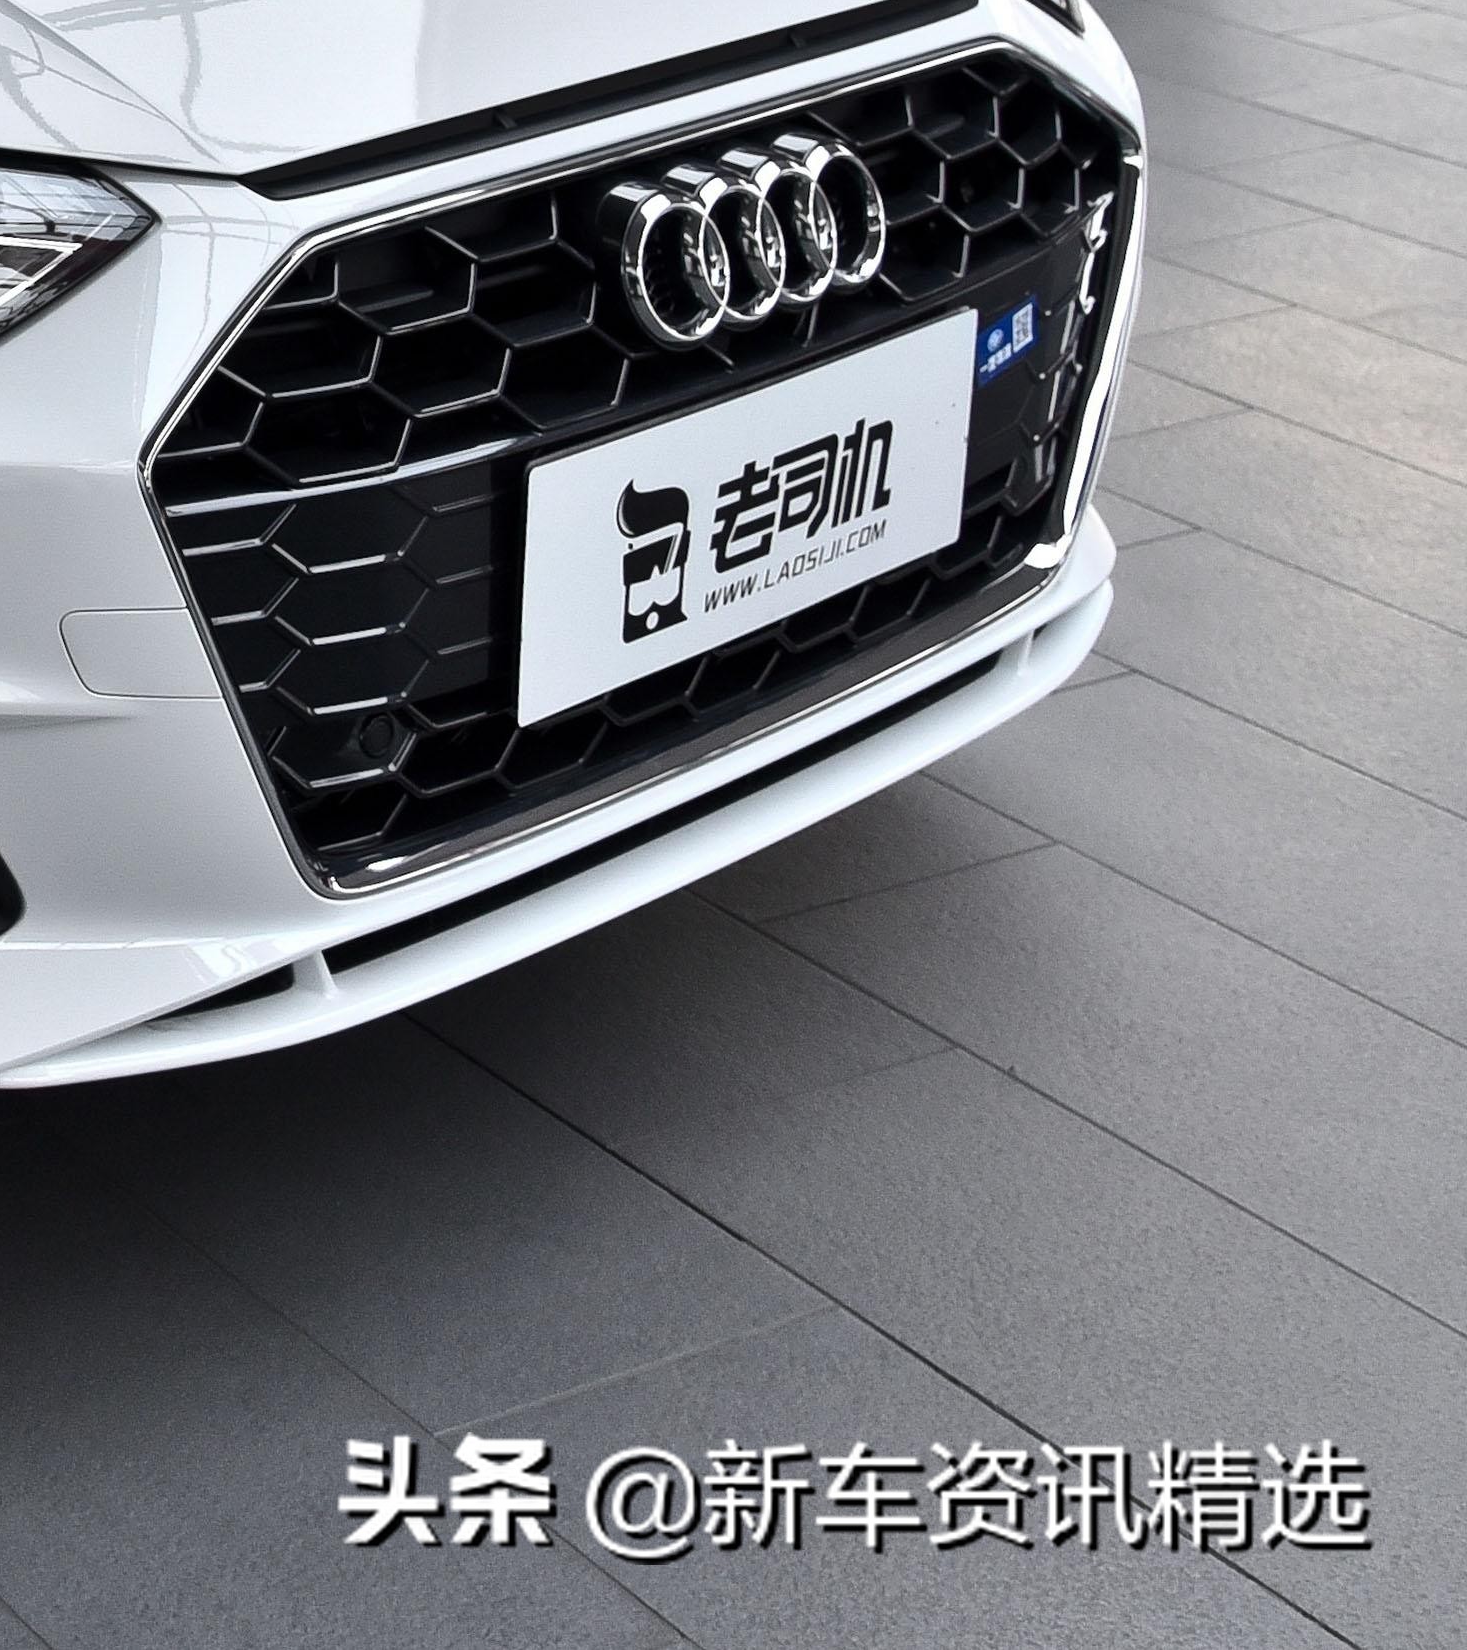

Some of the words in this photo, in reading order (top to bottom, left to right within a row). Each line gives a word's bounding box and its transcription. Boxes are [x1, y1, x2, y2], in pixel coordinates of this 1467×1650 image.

[709, 417, 893, 573] 老司机
[703, 519, 887, 613] WWW.LAOSIJI.COM
